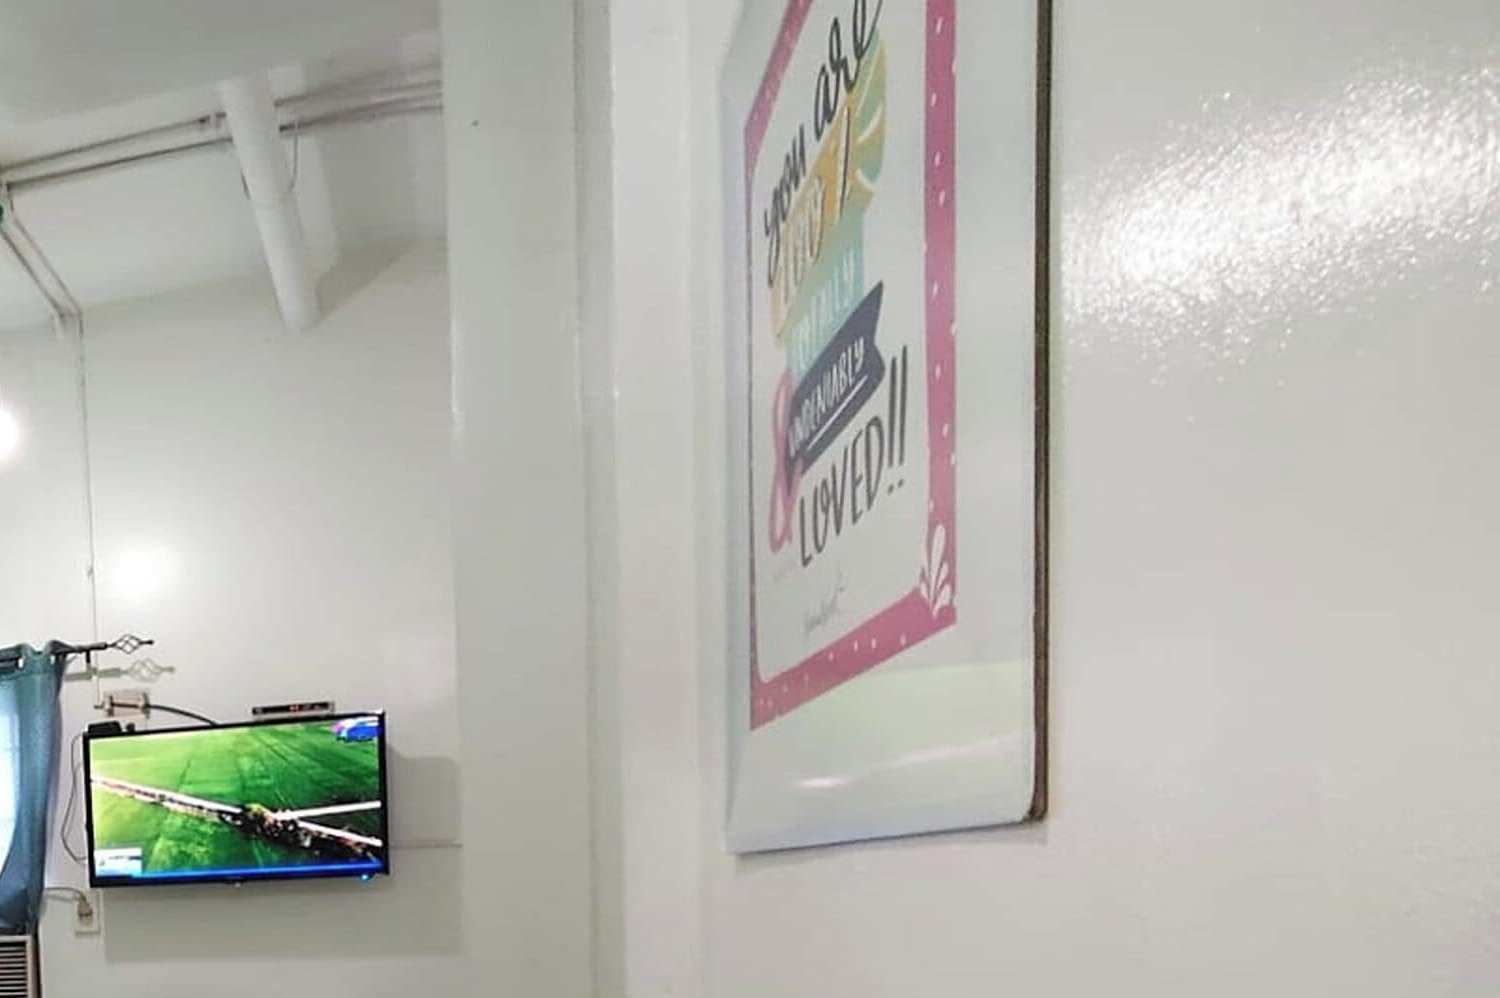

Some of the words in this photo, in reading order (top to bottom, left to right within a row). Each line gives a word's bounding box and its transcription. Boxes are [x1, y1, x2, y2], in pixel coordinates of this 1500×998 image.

[764, 123, 806, 289] you
[814, 0, 883, 142] are
[800, 345, 909, 567] LOVED!!
